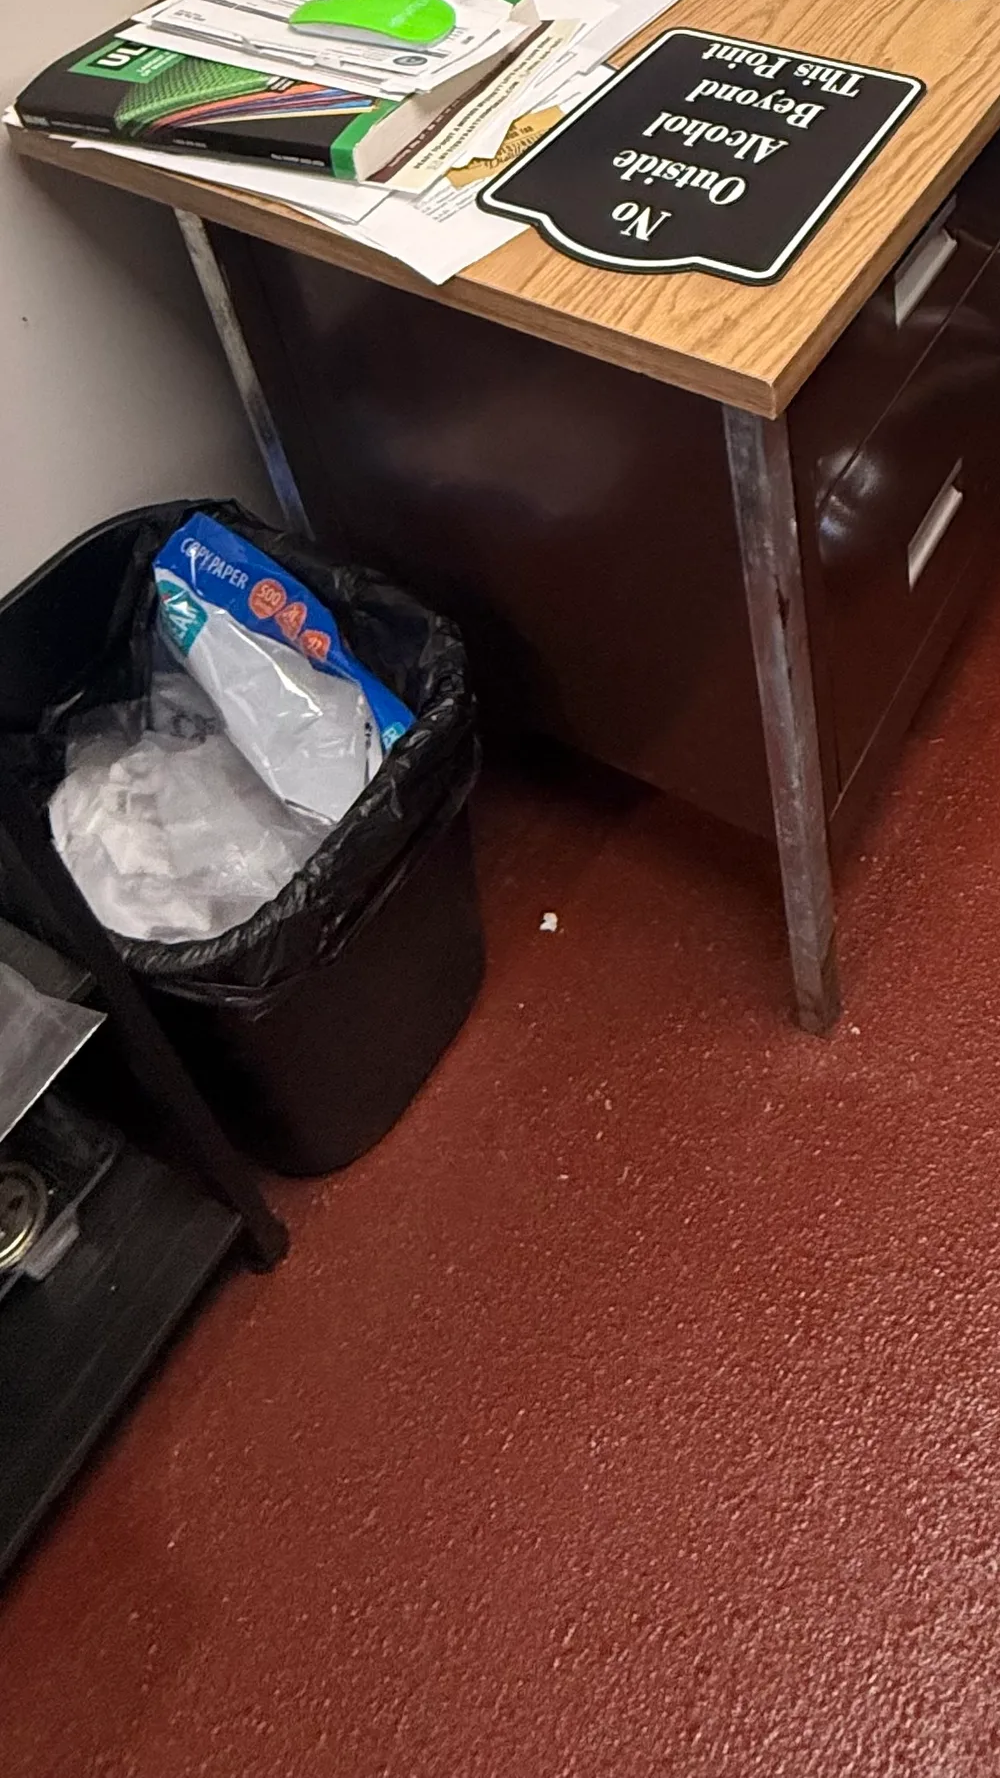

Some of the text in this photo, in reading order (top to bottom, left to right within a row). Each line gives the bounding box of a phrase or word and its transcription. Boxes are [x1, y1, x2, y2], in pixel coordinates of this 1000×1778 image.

[701, 42, 866, 98] This Point
[684, 78, 827, 130] Beyond
[641, 111, 790, 165] Alcohol
[612, 149, 747, 207] Outside
[610, 201, 672, 242] No
[180, 537, 250, 590] COPY PAPER
[258, 583, 282, 606] 500
